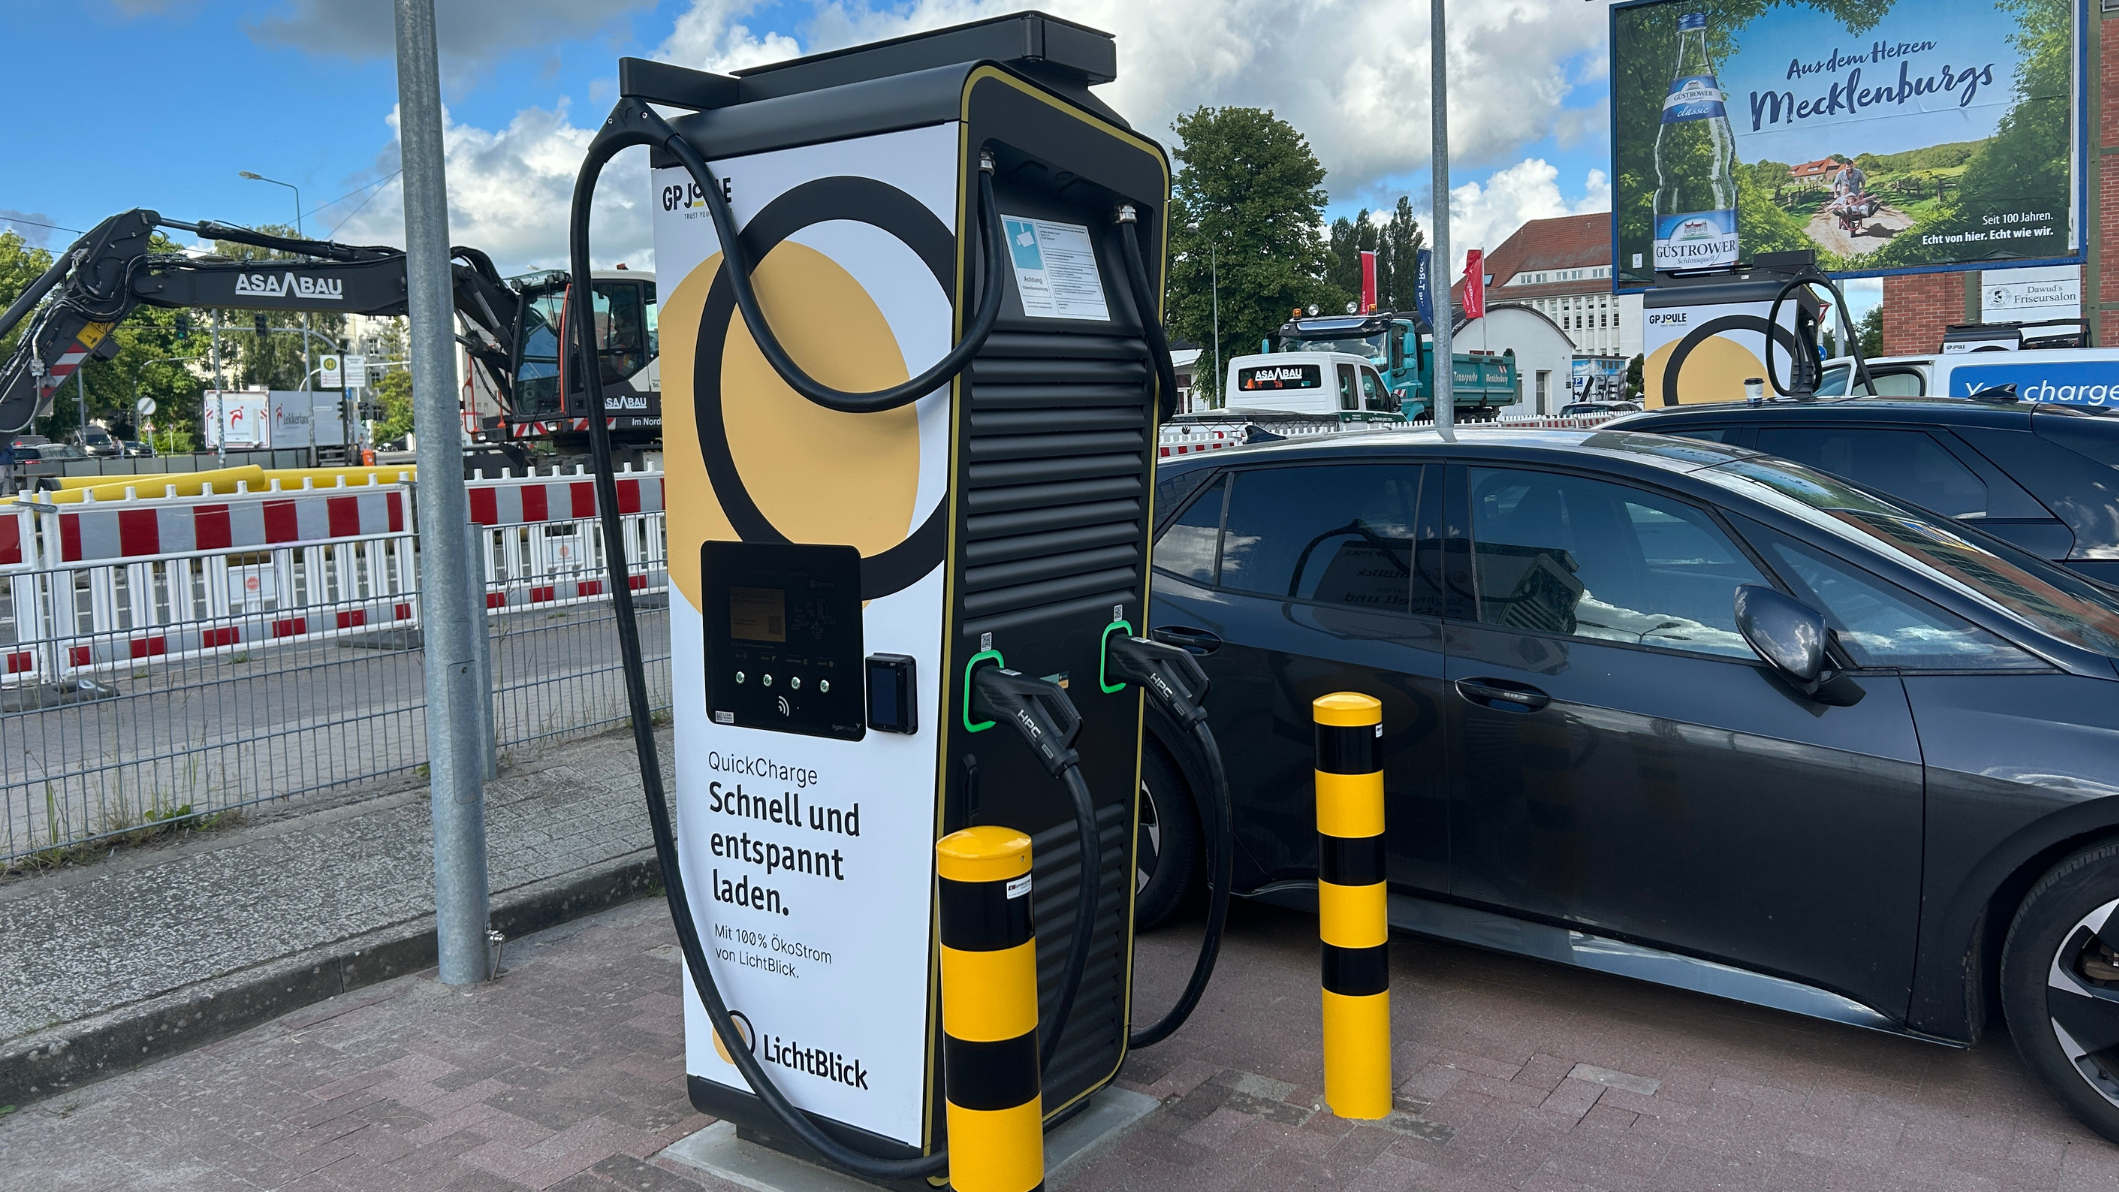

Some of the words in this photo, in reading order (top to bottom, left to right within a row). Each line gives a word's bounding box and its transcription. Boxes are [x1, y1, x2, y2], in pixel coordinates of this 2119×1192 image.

[1787, 58, 1825, 80] Aus
[1826, 48, 1870, 73] dem
[1871, 40, 1937, 63] Herzen
[1750, 60, 1995, 132] Mecklenburgs
[1677, 105, 1709, 118] classic
[662, 185, 683, 212] GP
[1982, 215, 2001, 226] Seit
[2002, 213, 2019, 224] 100
[2020, 211, 2053, 223] Jahren.
[1656, 239, 1736, 258] GÜSTROWER
[1922, 235, 1943, 245] Echt
[1945, 235, 1963, 243] von
[1965, 231, 1988, 242] hier.
[1990, 228, 2012, 240] Echt
[2013, 228, 2032, 238] wie
[2034, 225, 2054, 237] wir.
[1677, 255, 1716, 265] Schlossquell
[2014, 292, 2076, 304] Friseursalon
[1649, 315, 1660, 325] GP
[1661, 312, 1687, 323] JOULE
[632, 418, 642, 426] Im
[1149, 672, 1173, 698] HPC
[1017, 708, 1042, 739] HPC
[708, 751, 818, 788] QuickCharge
[709, 780, 802, 827] Schnell
[809, 802, 860, 837] und
[710, 832, 844, 880] entspannt
[713, 868, 789, 916] laden.
[714, 923, 733, 941] Mit
[735, 928, 767, 949] 100%
[771, 934, 832, 965] ÖkoStrom
[715, 947, 736, 963] von
[739, 952, 800, 979] LichtBlick.
[763, 1033, 869, 1091] LichtBlick
